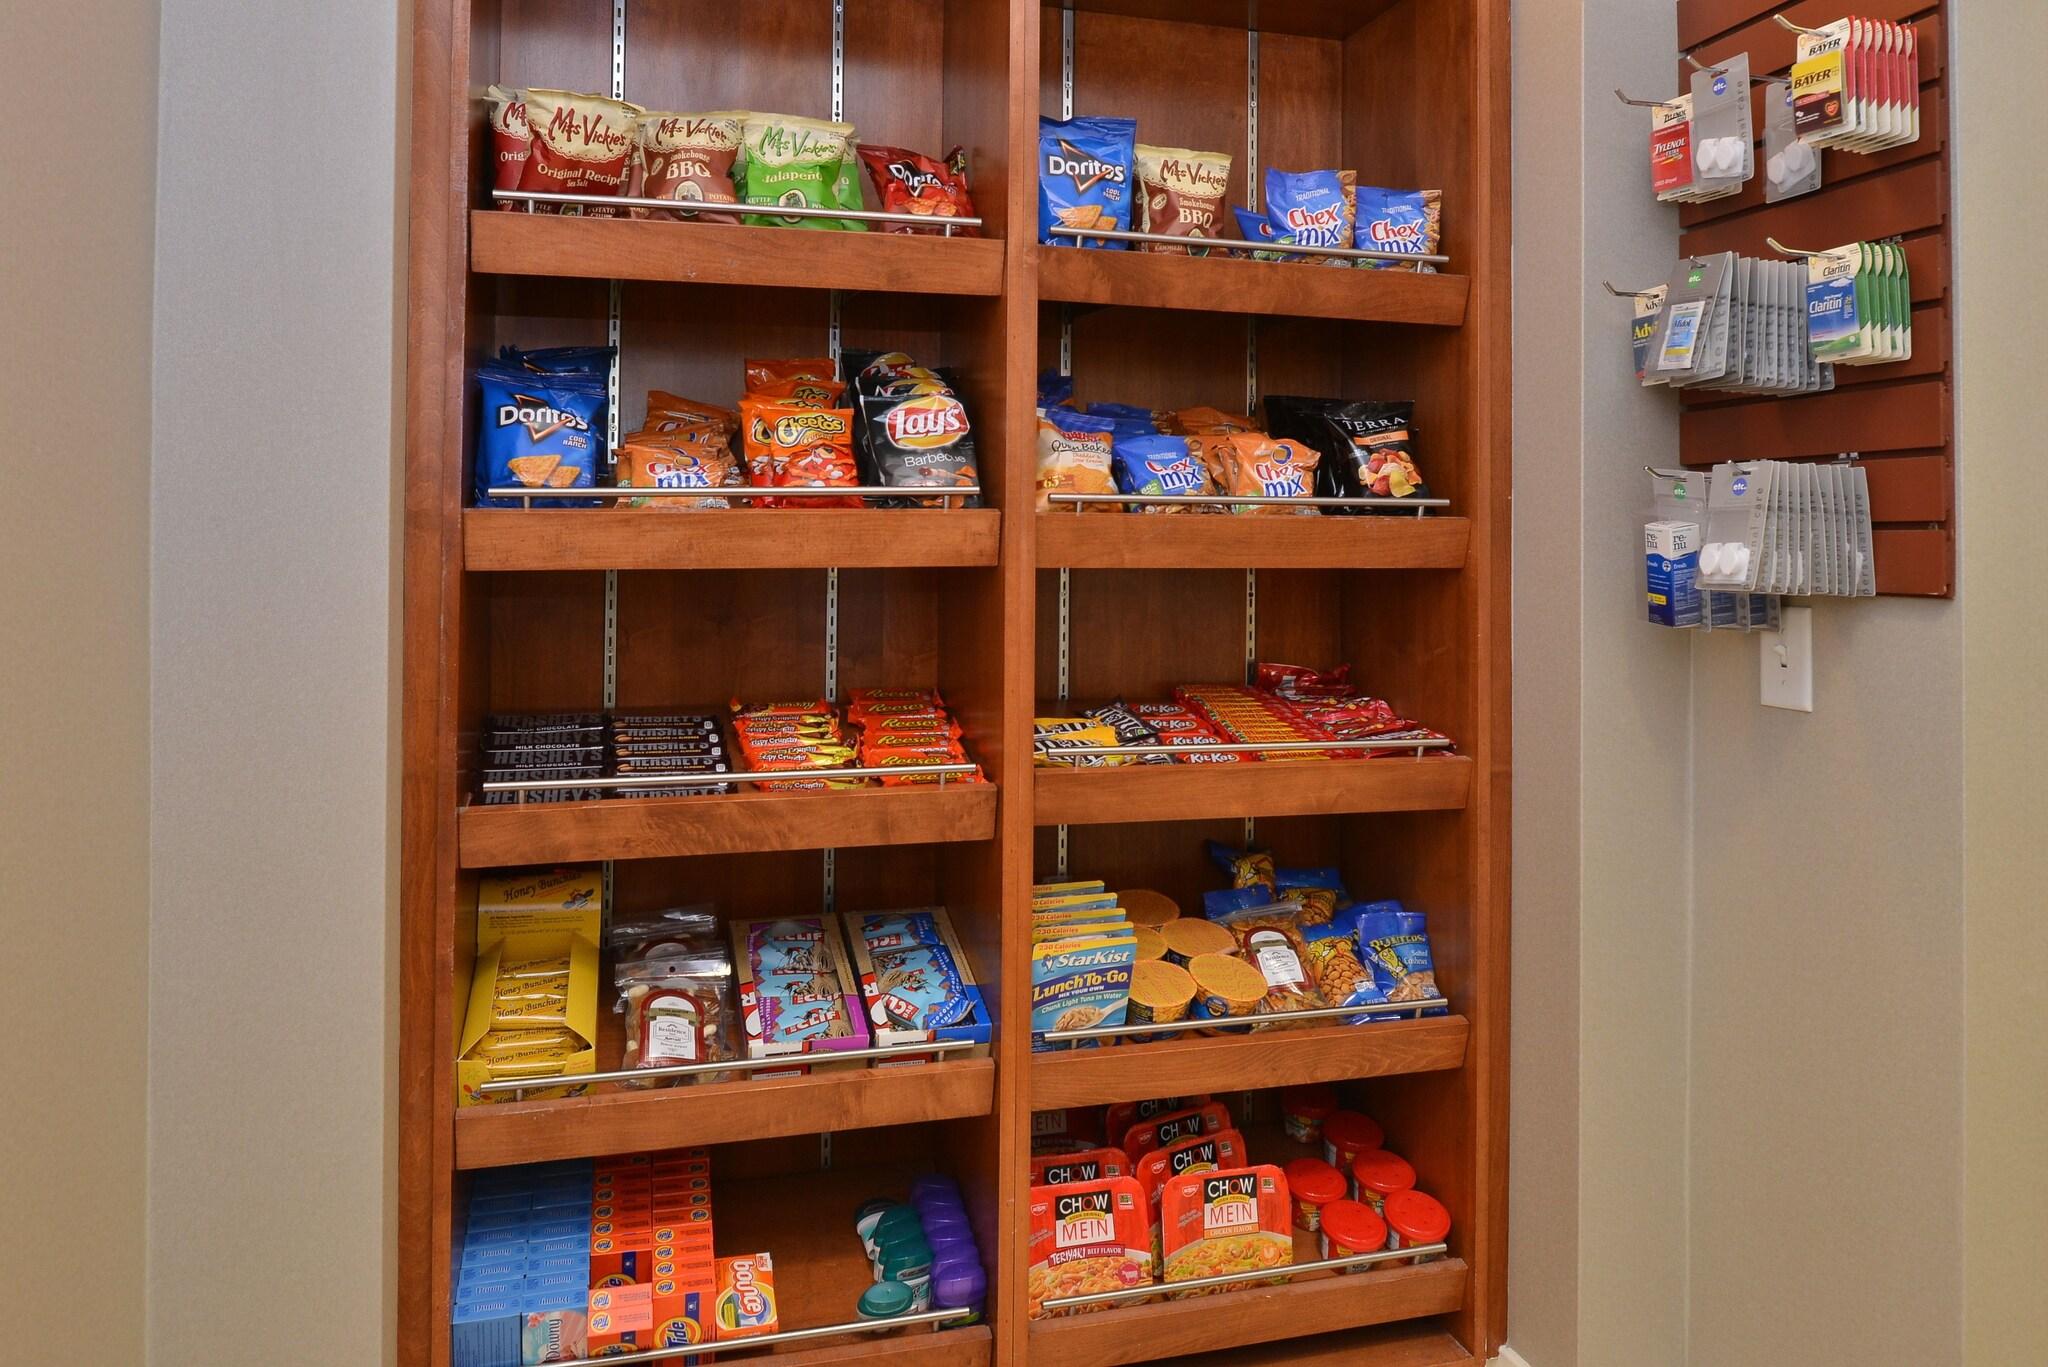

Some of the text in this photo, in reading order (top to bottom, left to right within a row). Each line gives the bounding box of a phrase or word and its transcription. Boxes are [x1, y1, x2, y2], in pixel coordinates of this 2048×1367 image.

[1808, 38, 1841, 56] BAYER
[1793, 69, 1832, 89] BAYER
[582, 113, 627, 152] Vickie's
[1653, 137, 1687, 155] TYLENOL
[537, 163, 584, 180] Original
[666, 160, 712, 180] BBQ
[888, 163, 957, 196] Doritos
[1049, 156, 1125, 183] Doritos
[1187, 163, 1227, 190] Vickie's
[1295, 188, 1330, 201] TRADITIONAL
[1178, 210, 1213, 229] BBQ
[1288, 203, 1341, 228] Chex
[1296, 224, 1341, 248] mix
[1370, 219, 1424, 242] Chex
[1378, 237, 1425, 254] mix
[1823, 263, 1851, 277] Claritin
[1809, 297, 1843, 314] Claritin
[500, 405, 589, 430] Doritos
[1342, 416, 1406, 432] TERRA
[568, 435, 587, 444] COOL
[774, 415, 844, 448] Cheetos
[562, 439, 588, 449] RANCH
[904, 452, 967, 468] Barbecue
[1159, 466, 1203, 491] mix
[1254, 462, 1304, 482] Chex
[1263, 473, 1307, 497] mix
[1673, 542, 1687, 551] nu
[881, 718, 939, 728] Reese's
[877, 735, 937, 745] Reese's
[503, 885, 537, 903] Honey
[1052, 927, 1079, 935] Calories
[1054, 942, 1081, 950] Calories
[1056, 950, 1130, 968] StarKist
[495, 977, 558, 999] Honey Bunchies
[1033, 975, 1083, 1001] Lunch
[1058, 985, 1105, 999] MIX YOUR OWN
[497, 998, 561, 1018] Honey Bunchies
[1041, 1002, 1062, 1014] Chunk
[1062, 998, 1079, 1009] Light
[1080, 995, 1095, 1004] Tuna
[1103, 991, 1122, 1000] Water
[797, 1010, 840, 1030] CLIF
[486, 1052, 514, 1066] Honey
[1035, 1114, 1063, 1131] EIN
[1173, 1144, 1213, 1170] CHOW
[1048, 1164, 1096, 1184] CHOW
[1207, 1176, 1254, 1198] CHOW
[1059, 1193, 1109, 1214] CHOW
[1210, 1203, 1253, 1226] MEIN
[1062, 1219, 1109, 1242] MEIN
[1050, 1247, 1122, 1266] TERIYAKI BEEF FLAVOR
[729, 1260, 765, 1316] bounce
[545, 1318, 563, 1362] Downy
[665, 1320, 688, 1347] Tide
